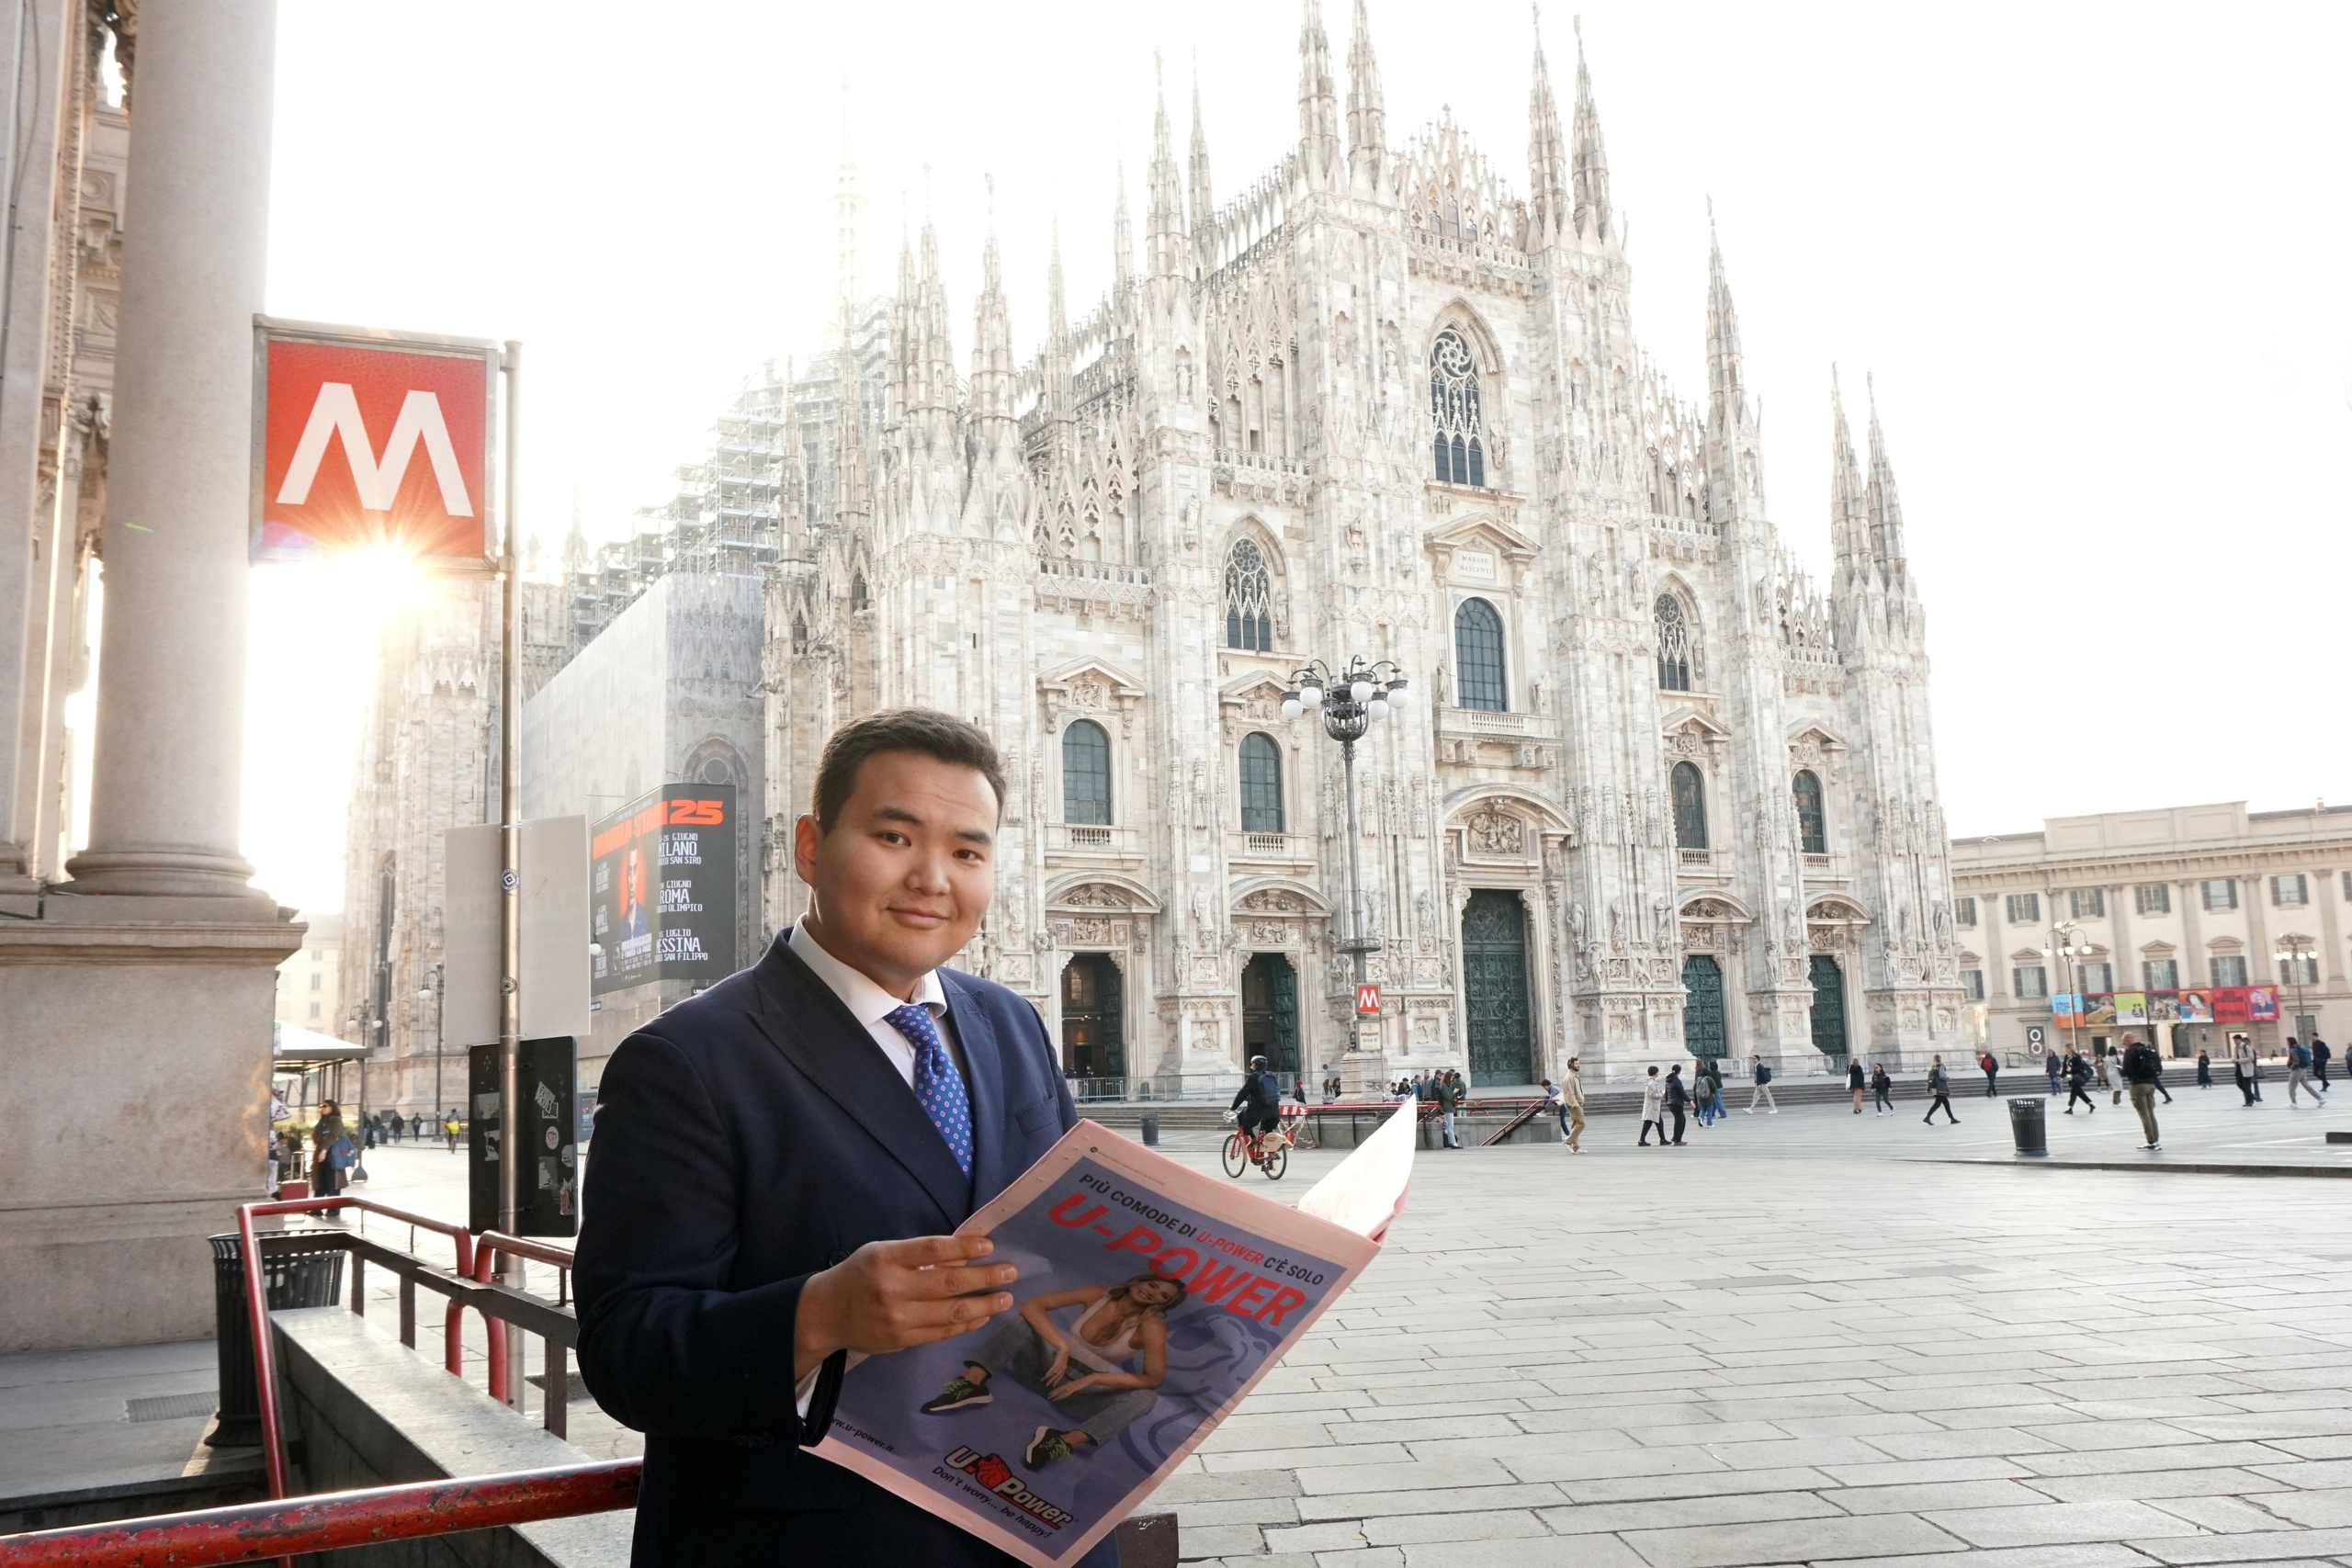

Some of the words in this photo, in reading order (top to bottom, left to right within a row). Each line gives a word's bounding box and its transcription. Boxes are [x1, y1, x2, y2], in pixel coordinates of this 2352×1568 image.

[276, 381, 475, 517] M
[1462, 555, 1488, 564] MARIAE
[1459, 565, 1492, 574] NASCENTI
[672, 832, 698, 841] GIUGNO
[670, 856, 683, 864] SAN
[684, 856, 702, 865] SIRO
[666, 879, 692, 889] GIUGNO
[660, 888, 690, 905] ROMA
[668, 903, 703, 912] OLIMPICO
[665, 928, 692, 938] LUGLIO
[663, 953, 675, 962] SAN
[677, 952, 708, 961] FILIPPO
[1360, 989, 1379, 1008] M
[1079, 1174, 1111, 1194] PIÙ
[1110, 1190, 1181, 1230] COMODE
[1177, 1223, 1198, 1238] DI
[1196, 1231, 1265, 1265] U-POWER
[1263, 1257, 1288, 1273] C'È
[1286, 1265, 1325, 1286] SOLO
[1047, 1192, 1307, 1327] U-POWER
[932, 1466, 963, 1487] Don't
[963, 1483, 998, 1509] worry...
[1001, 1506, 1015, 1517] be
[1015, 1515, 1054, 1540] happy!
